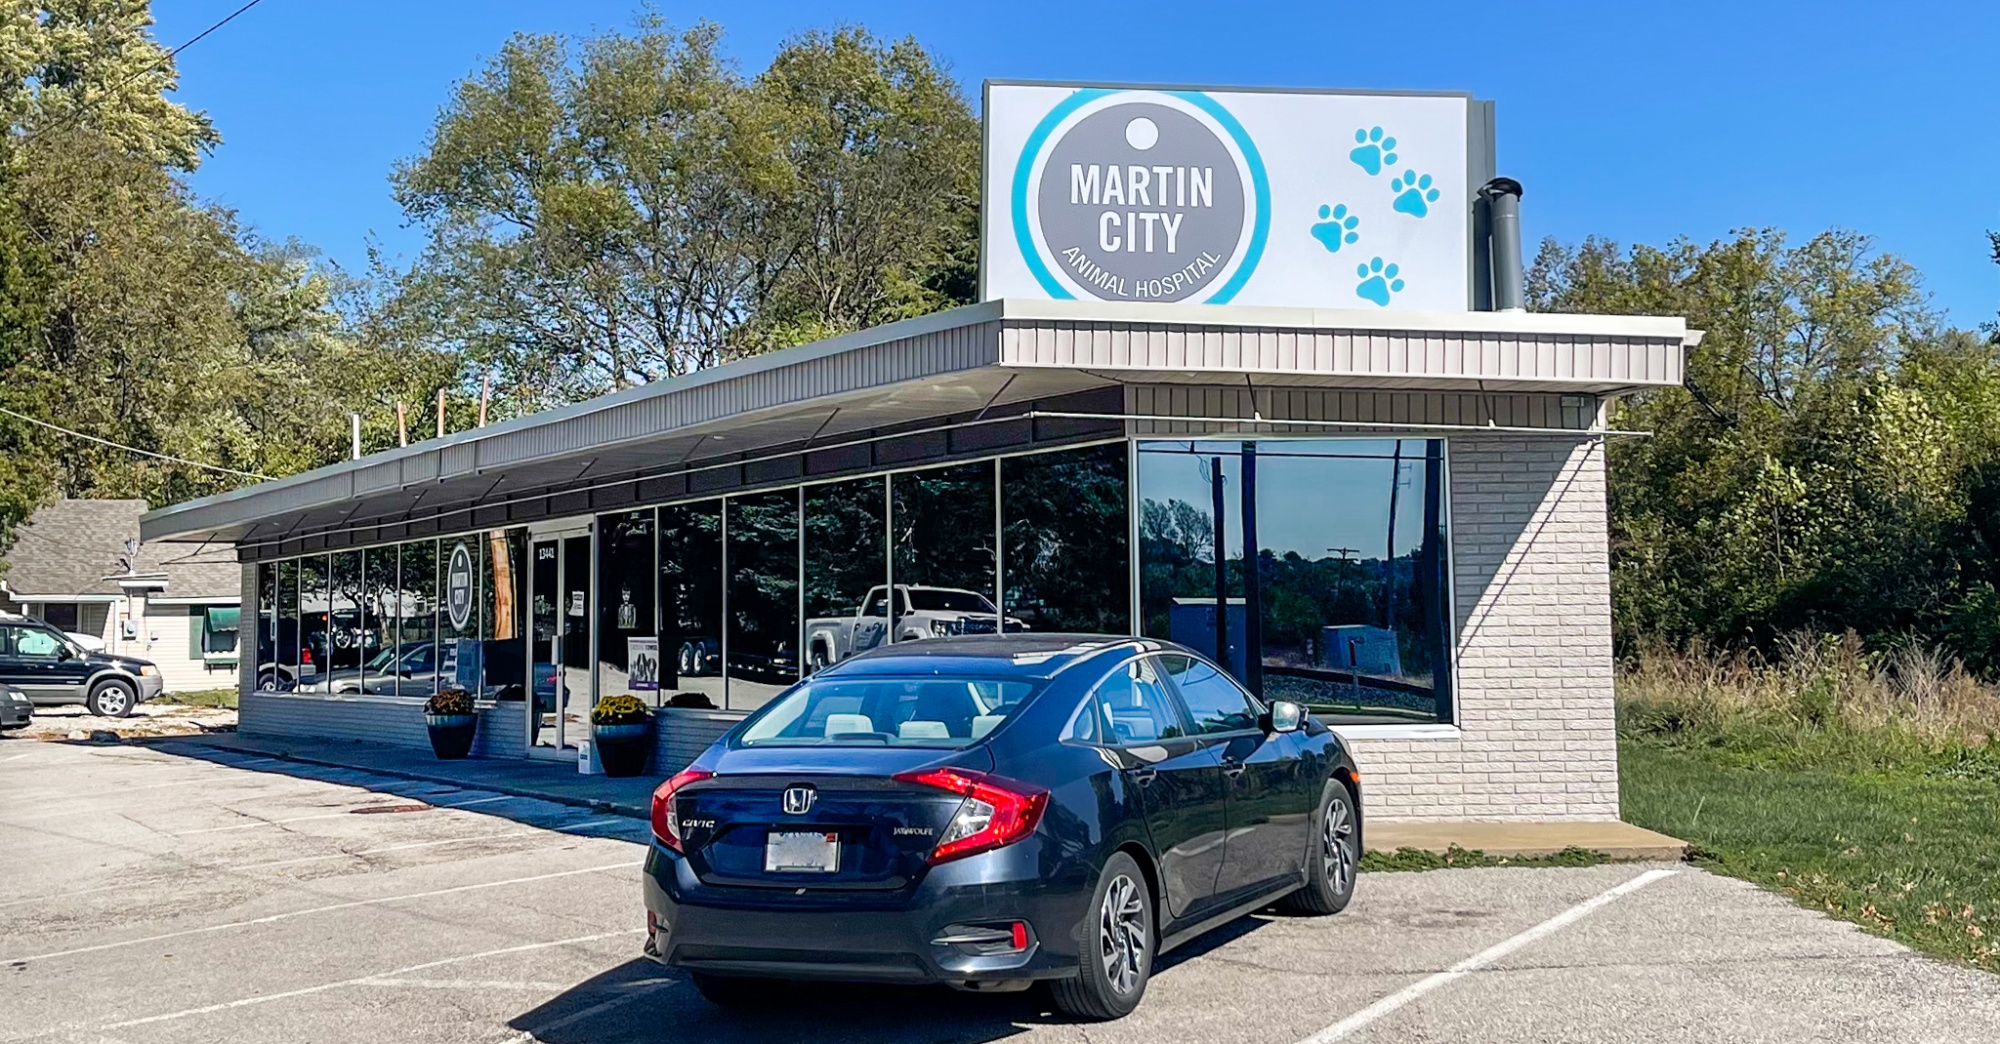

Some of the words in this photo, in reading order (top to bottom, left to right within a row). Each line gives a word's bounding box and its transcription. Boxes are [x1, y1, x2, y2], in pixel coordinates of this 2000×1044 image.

[1070, 164, 1213, 207] MARTIN
[1100, 211, 1184, 254] CITY
[1062, 246, 1128, 297] ANIMAL
[1135, 251, 1222, 298] HOSPITAL
[682, 819, 715, 828] CIVIC
